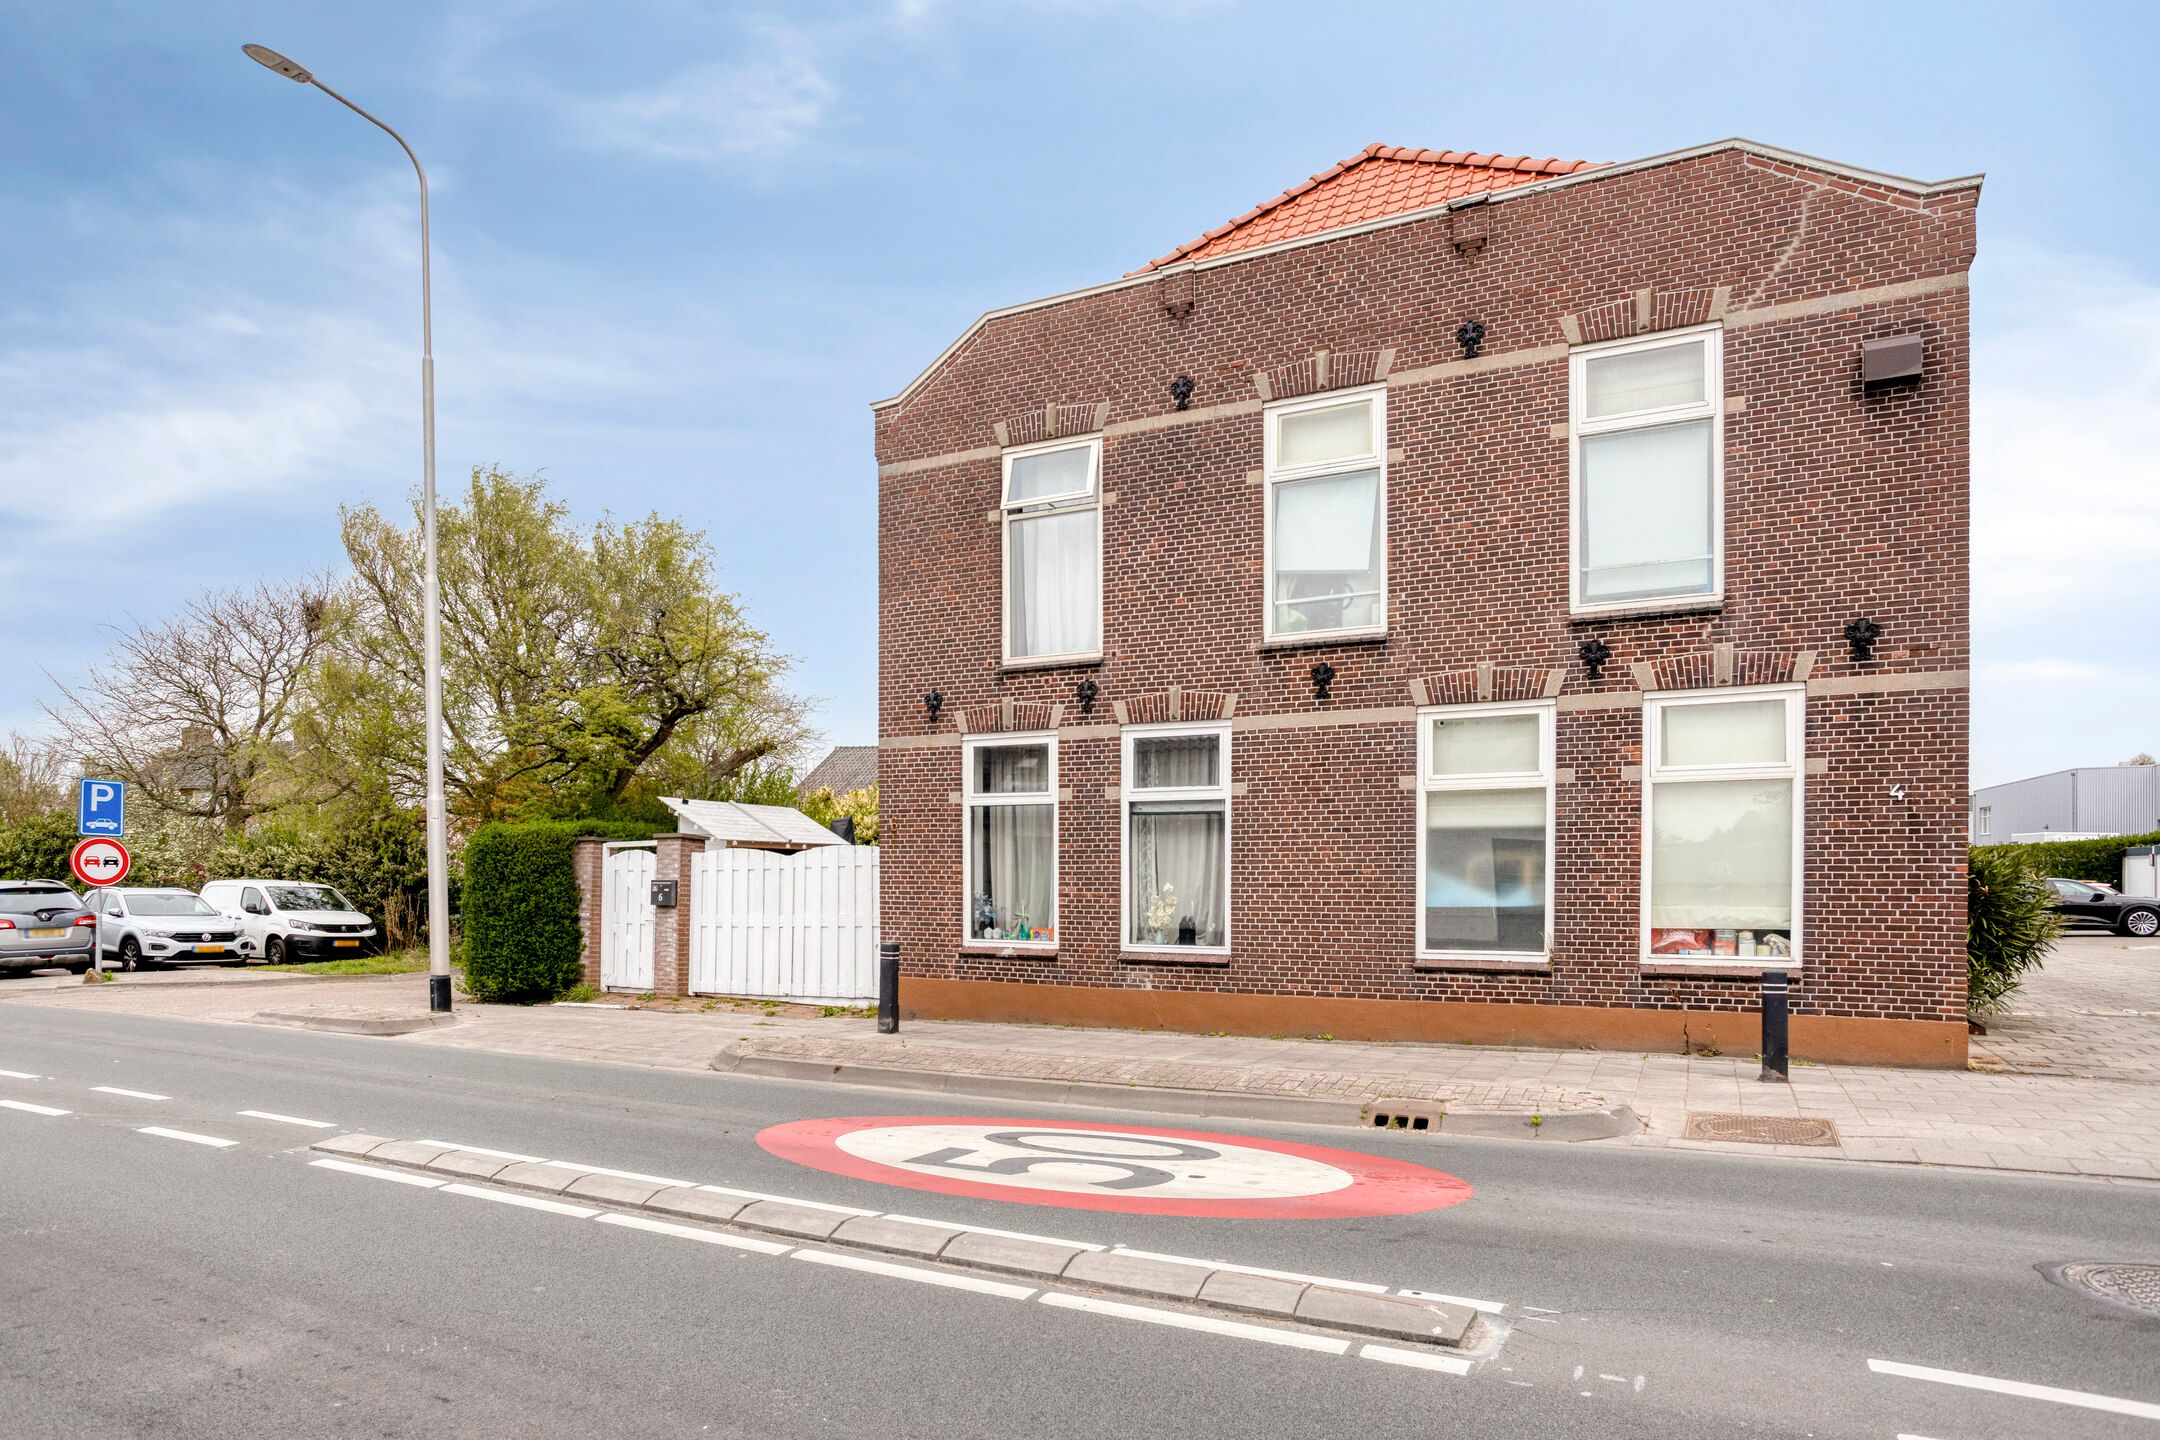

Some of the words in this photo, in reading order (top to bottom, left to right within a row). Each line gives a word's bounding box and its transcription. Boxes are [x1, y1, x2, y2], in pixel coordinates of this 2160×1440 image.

[91, 784, 114, 811] P
[1889, 783, 1905, 800] 4
[658, 893, 663, 901] 6
[901, 1131, 1221, 1190] 50
